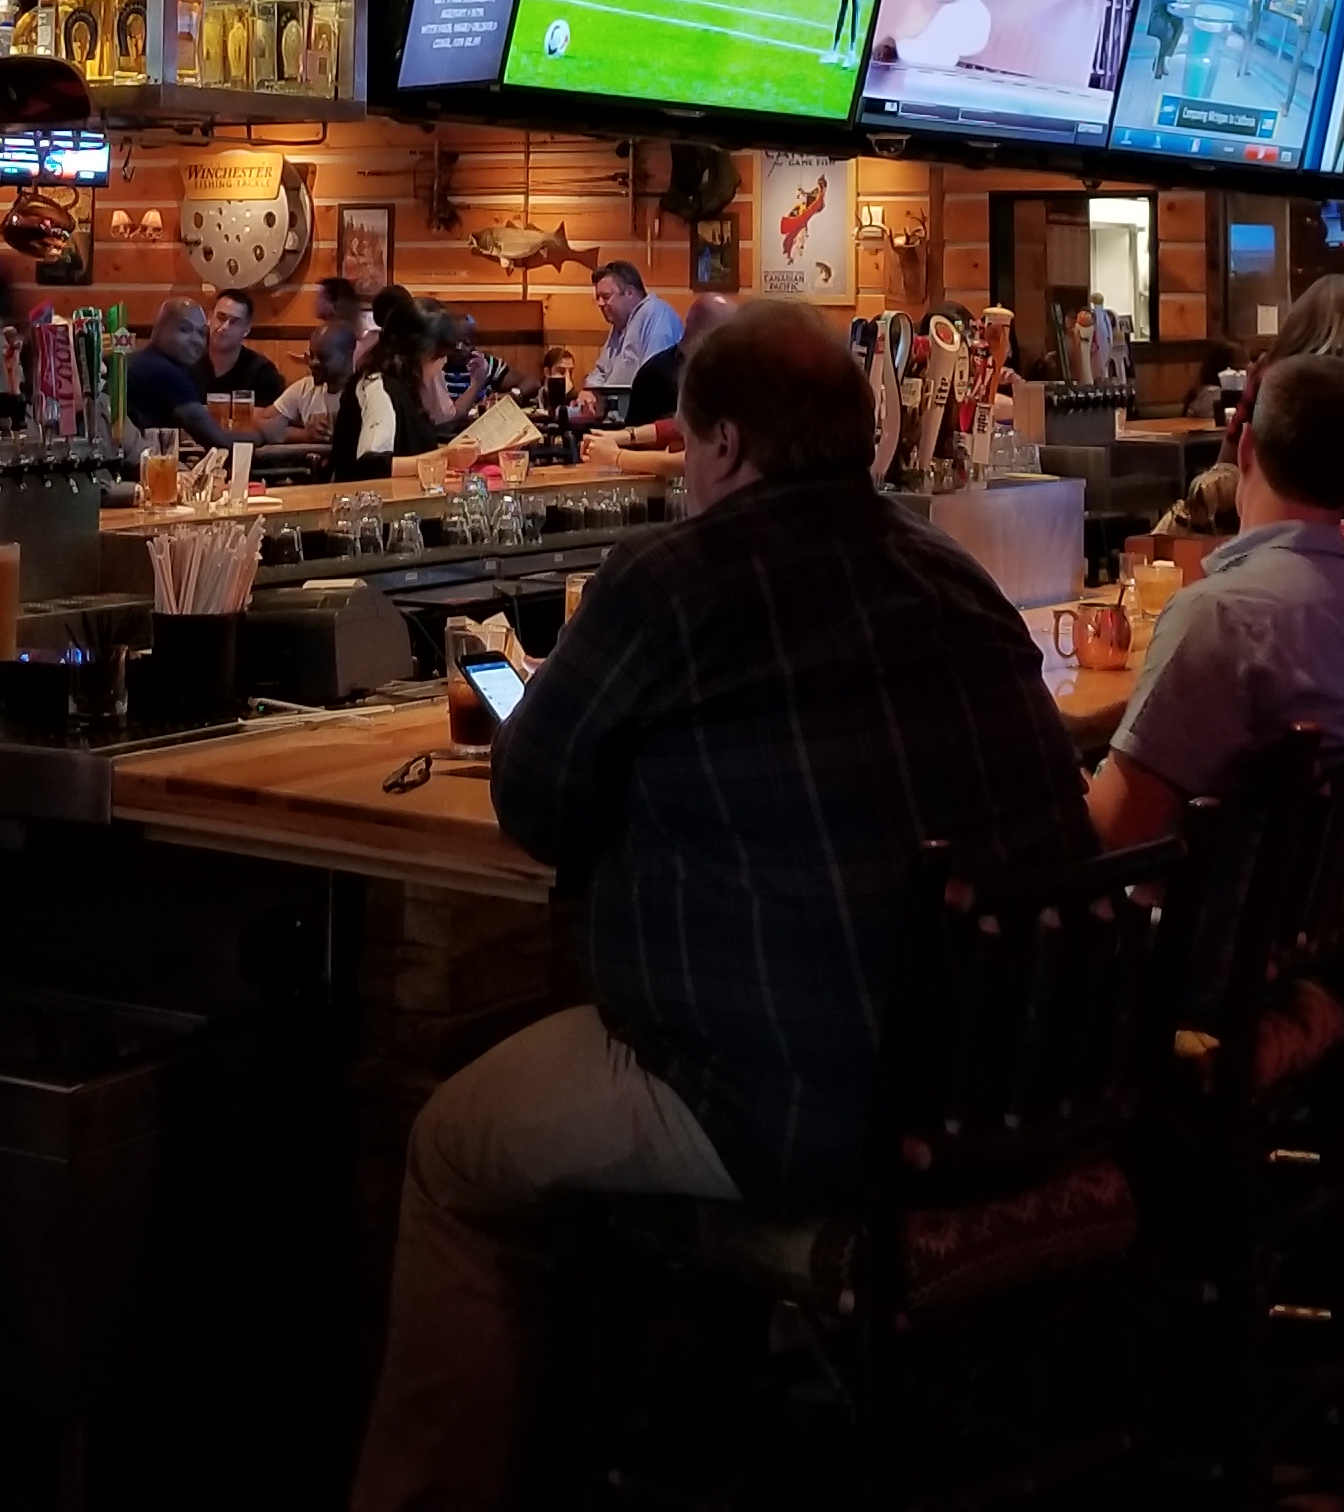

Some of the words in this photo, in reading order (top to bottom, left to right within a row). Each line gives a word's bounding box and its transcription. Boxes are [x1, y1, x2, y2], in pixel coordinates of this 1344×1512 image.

[788, 158, 812, 167] GAME
[187, 163, 273, 181] WINCHESTER
[194, 178, 233, 190] FISHING
[764, 274, 805, 284] CANADIAN
